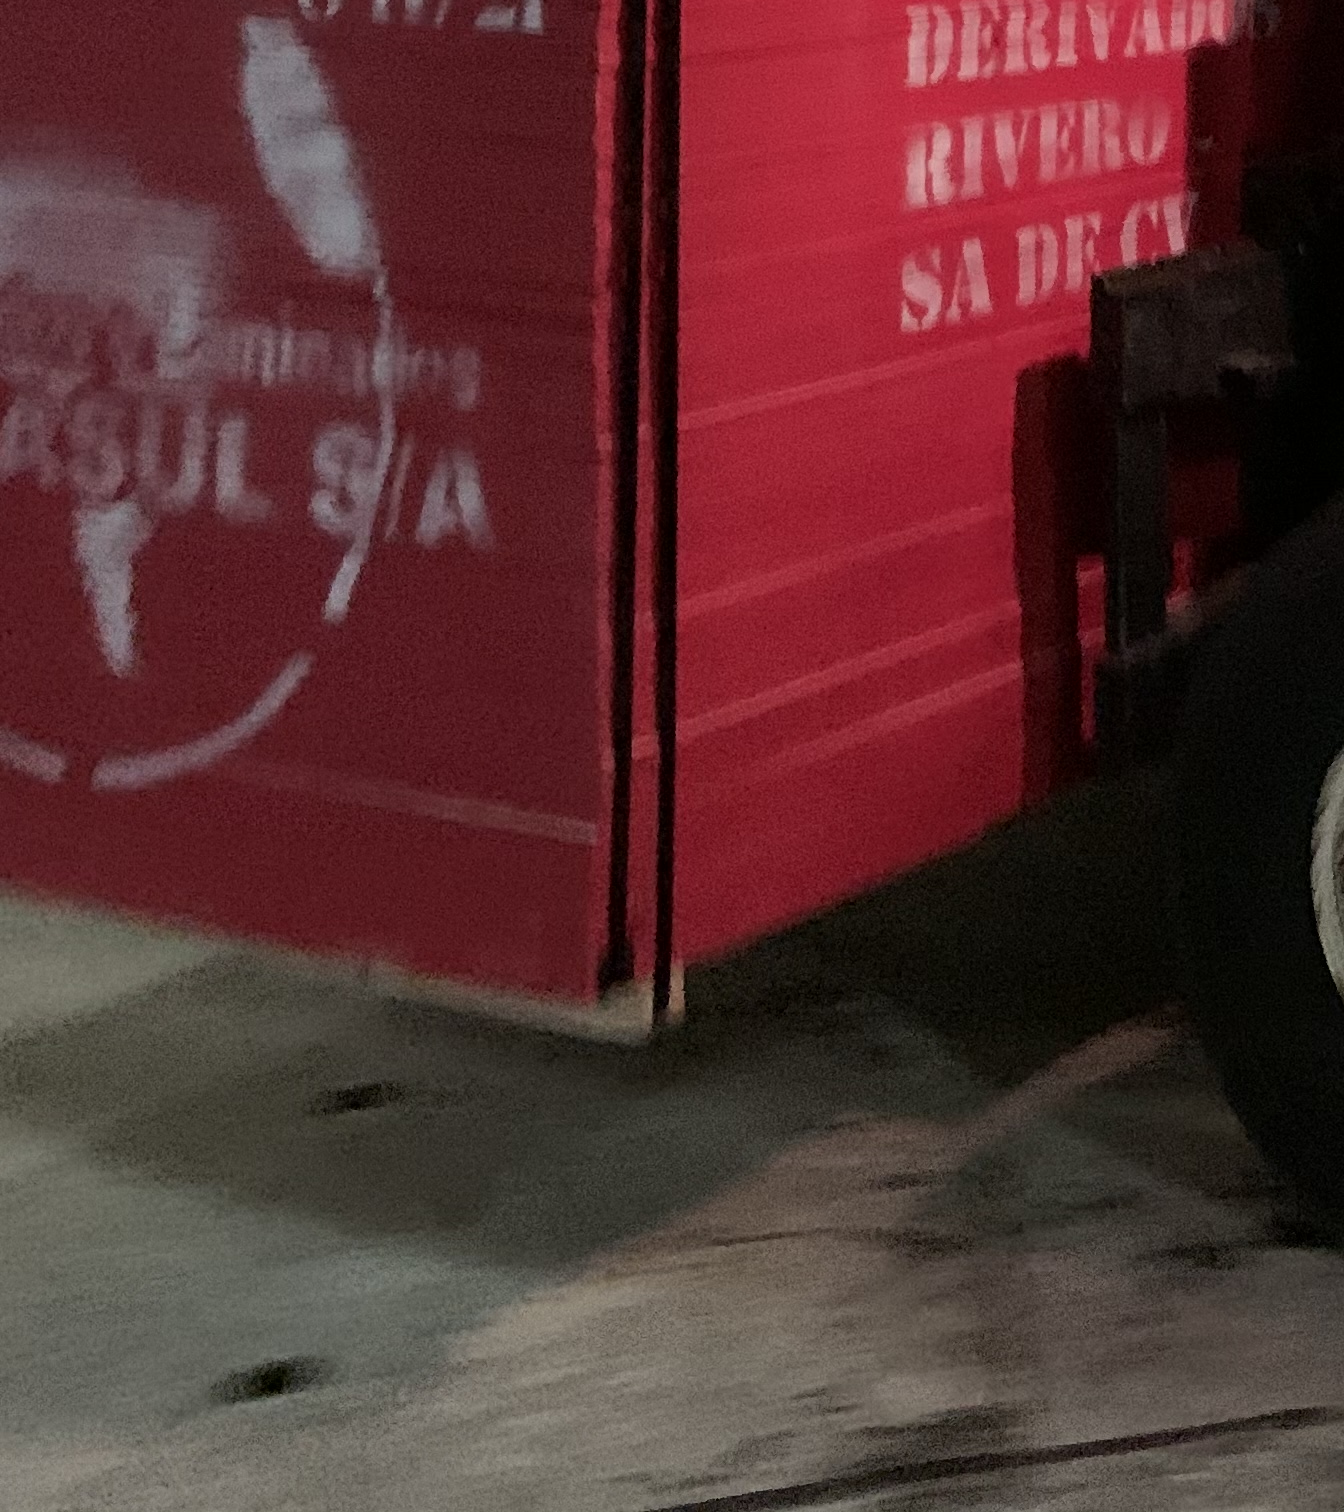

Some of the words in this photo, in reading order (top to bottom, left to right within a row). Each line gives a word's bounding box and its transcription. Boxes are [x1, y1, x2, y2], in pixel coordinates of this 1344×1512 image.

[904, 96, 1174, 211] RIVERO
[900, 236, 994, 333] SA
[1016, 210, 1102, 306] DE
[0, 393, 274, 525] ASUL
